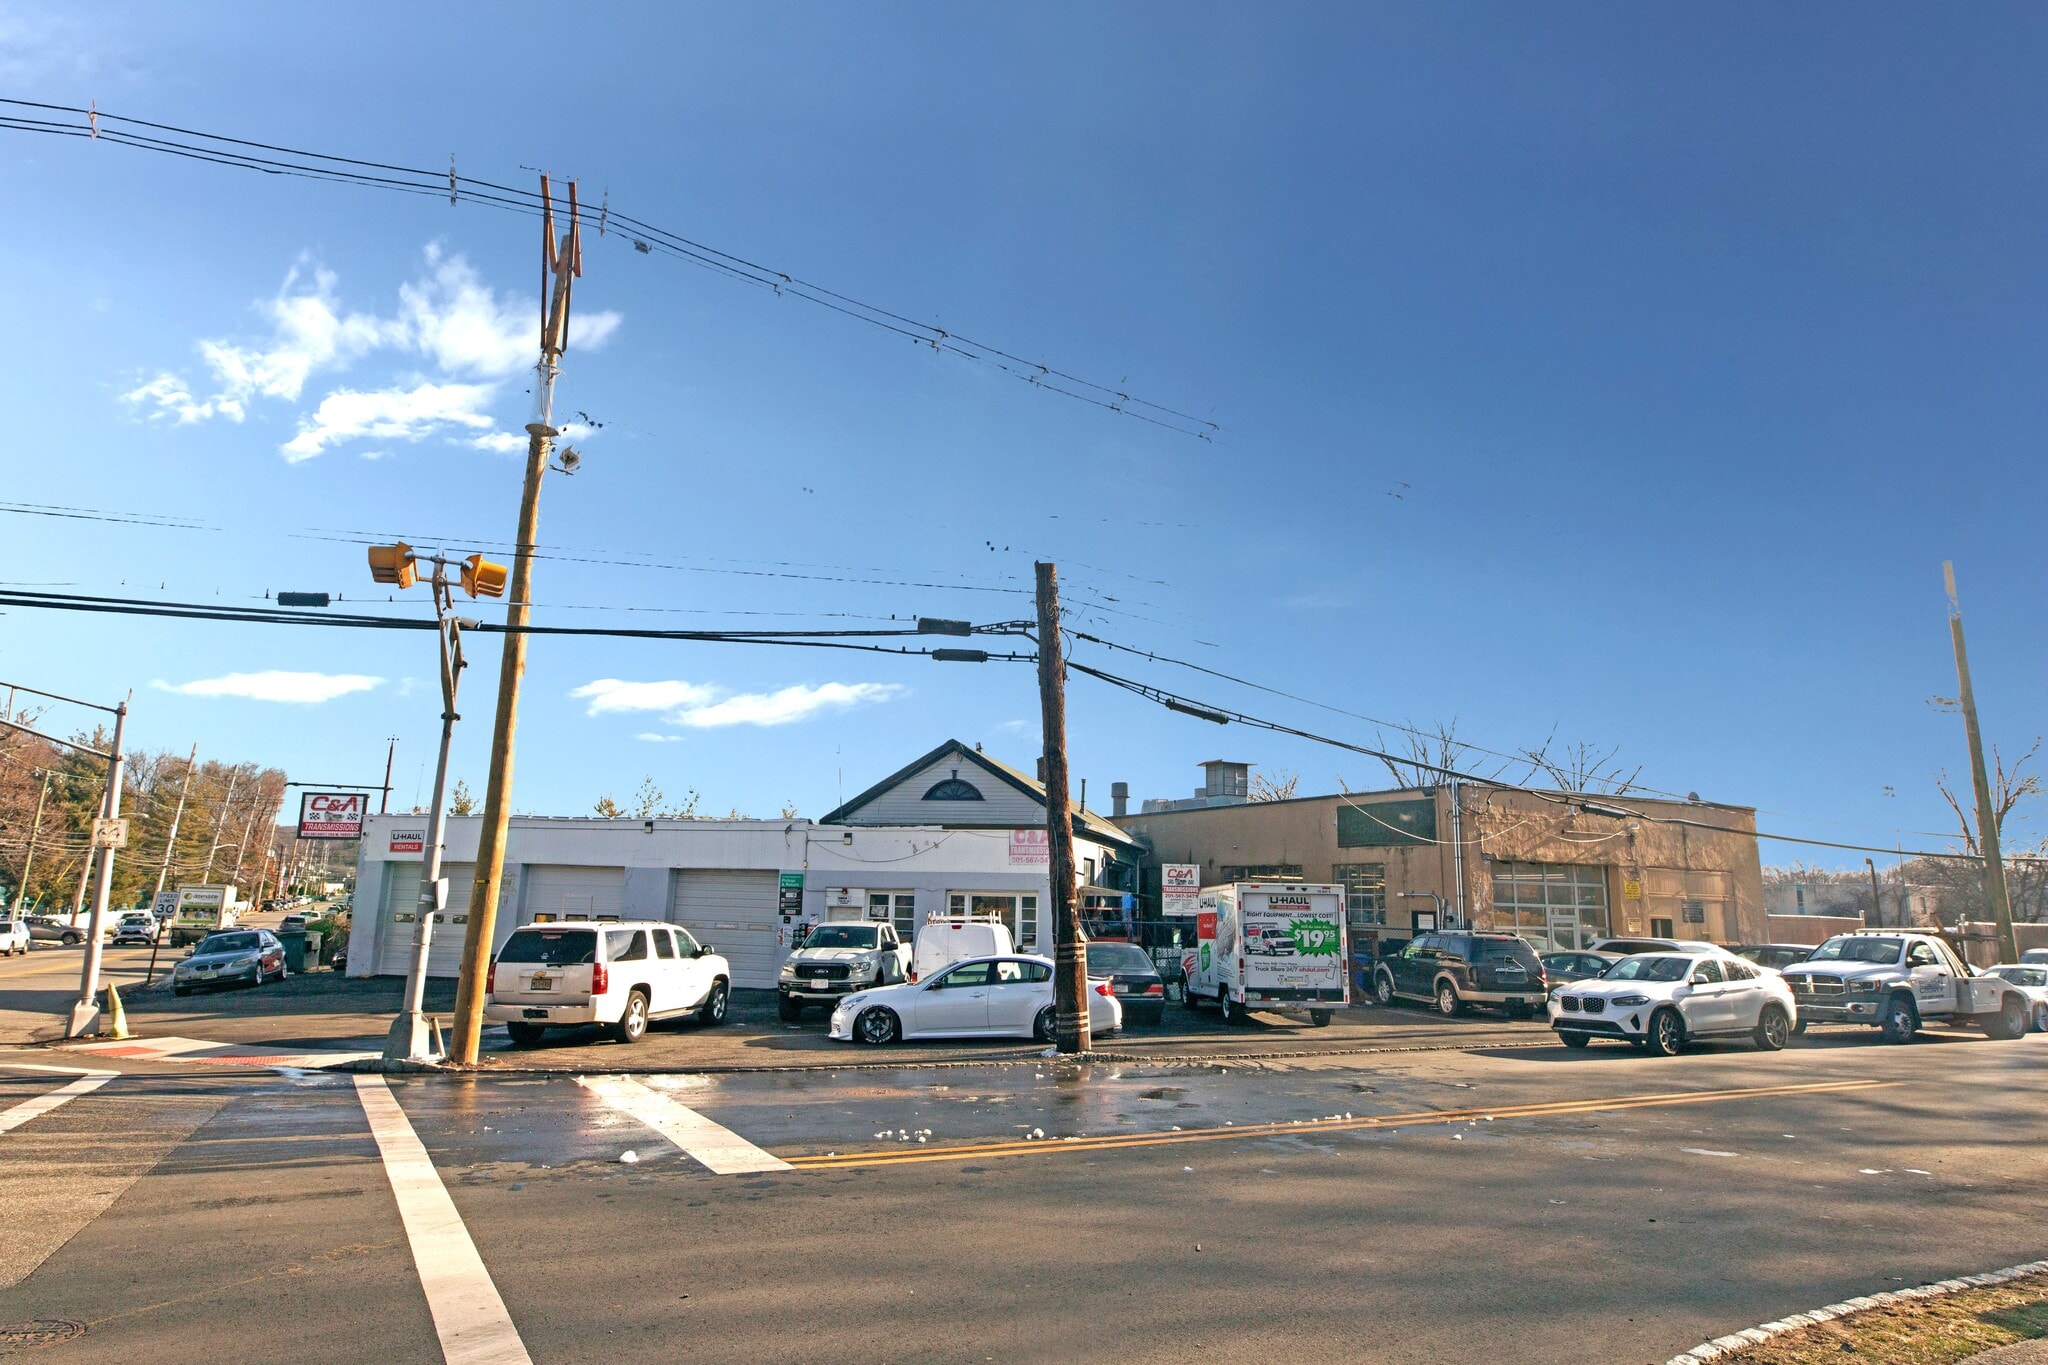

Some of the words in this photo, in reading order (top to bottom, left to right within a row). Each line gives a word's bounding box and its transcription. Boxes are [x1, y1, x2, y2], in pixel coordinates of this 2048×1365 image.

[310, 795, 358, 812] C&A
[305, 823, 360, 832] TRANSMISSIONS
[1167, 868, 1193, 879] C&A
[1199, 897, 1217, 909] U-HAUL
[1270, 896, 1310, 905] U-HAUL
[156, 903, 175, 914] 30
